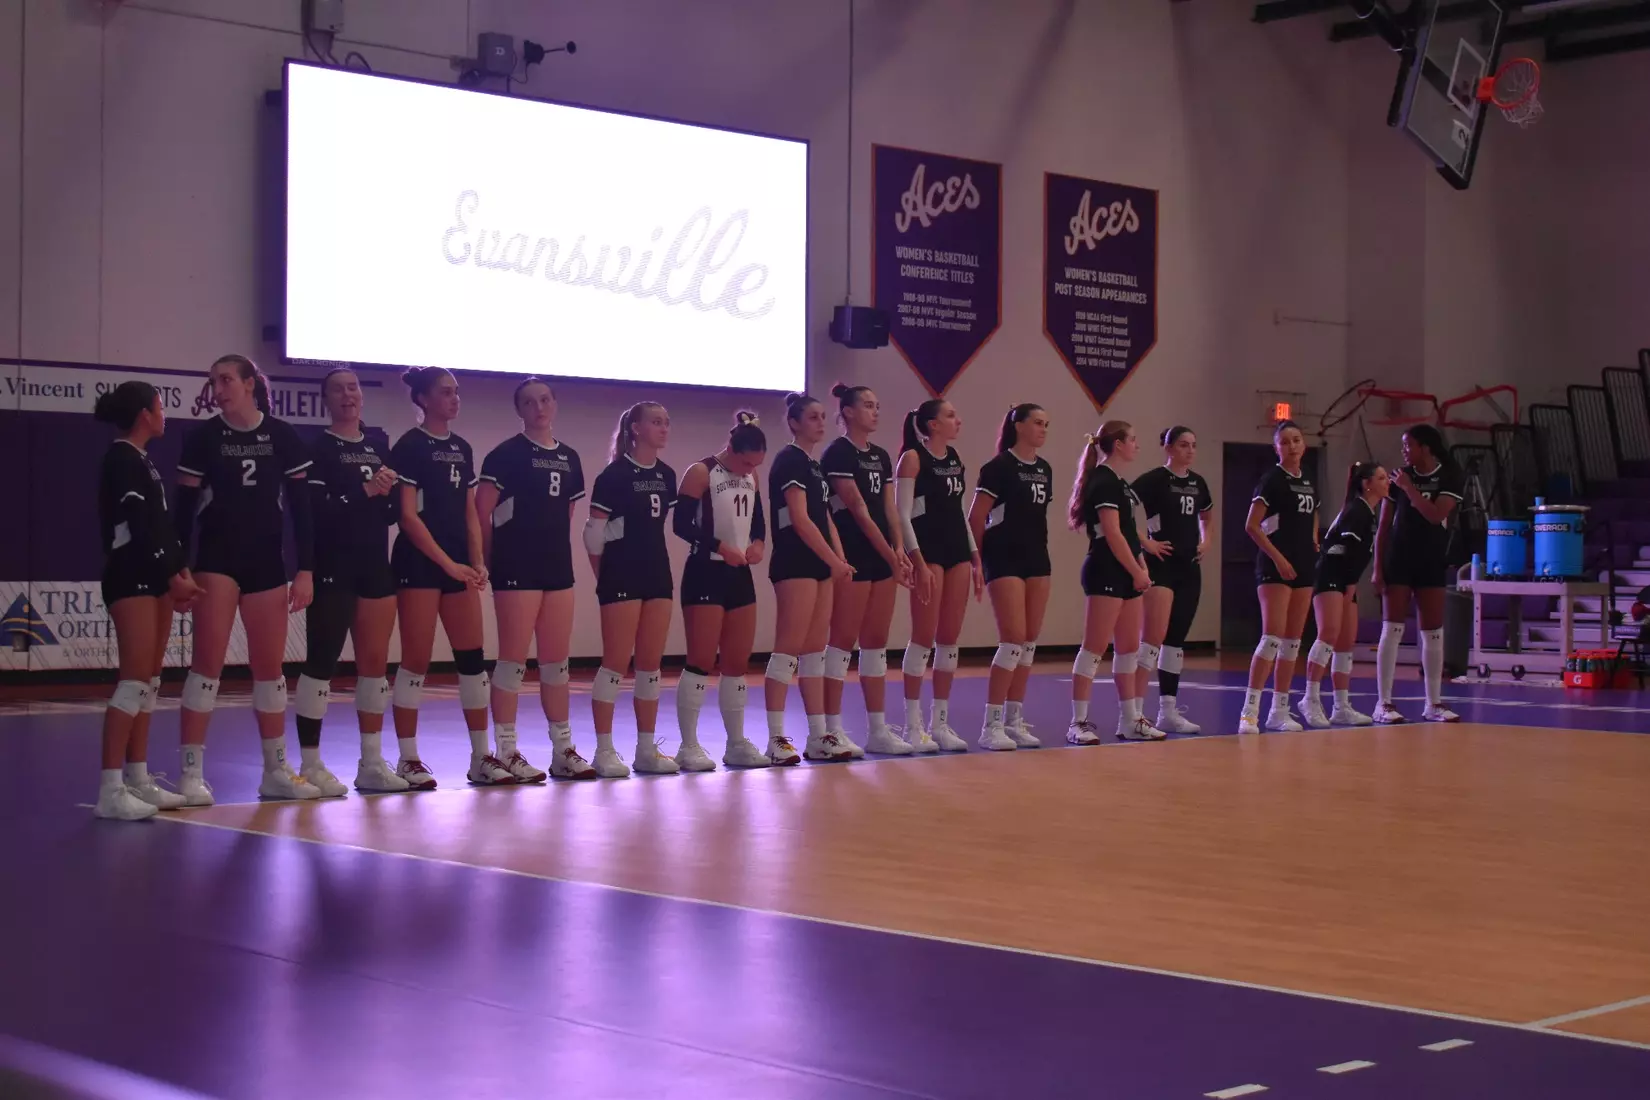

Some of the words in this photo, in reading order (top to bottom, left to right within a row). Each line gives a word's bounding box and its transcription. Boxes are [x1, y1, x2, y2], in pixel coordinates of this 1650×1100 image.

[441, 188, 776, 320] Evansville
[895, 245, 933, 262] WOMEN'S
[934, 250, 979, 267] BASKETBALL
[900, 264, 949, 281] CONFERENCE
[950, 270, 975, 284] TITLES
[1064, 266, 1097, 282] WOMEN'S
[1098, 271, 1138, 287] BASKETBALL
[1054, 282, 1073, 295] POST
[1074, 284, 1100, 299] SEASON
[1101, 288, 1147, 304] APPEARANCES
[5, 377, 84, 399] Vincent
[241, 459, 257, 486] 2
[449, 463, 462, 489] 4
[869, 471, 881, 494] 13
[549, 471, 561, 497] 8
[946, 477, 964, 497] 14
[1030, 483, 1047, 504] 15
[650, 493, 661, 518] 9
[733, 494, 748, 517] 11
[1180, 495, 1195, 515] 18
[1297, 493, 1315, 514] 20
[1534, 523, 1568, 532] OWERADE
[1573, 674, 1582, 685] G
